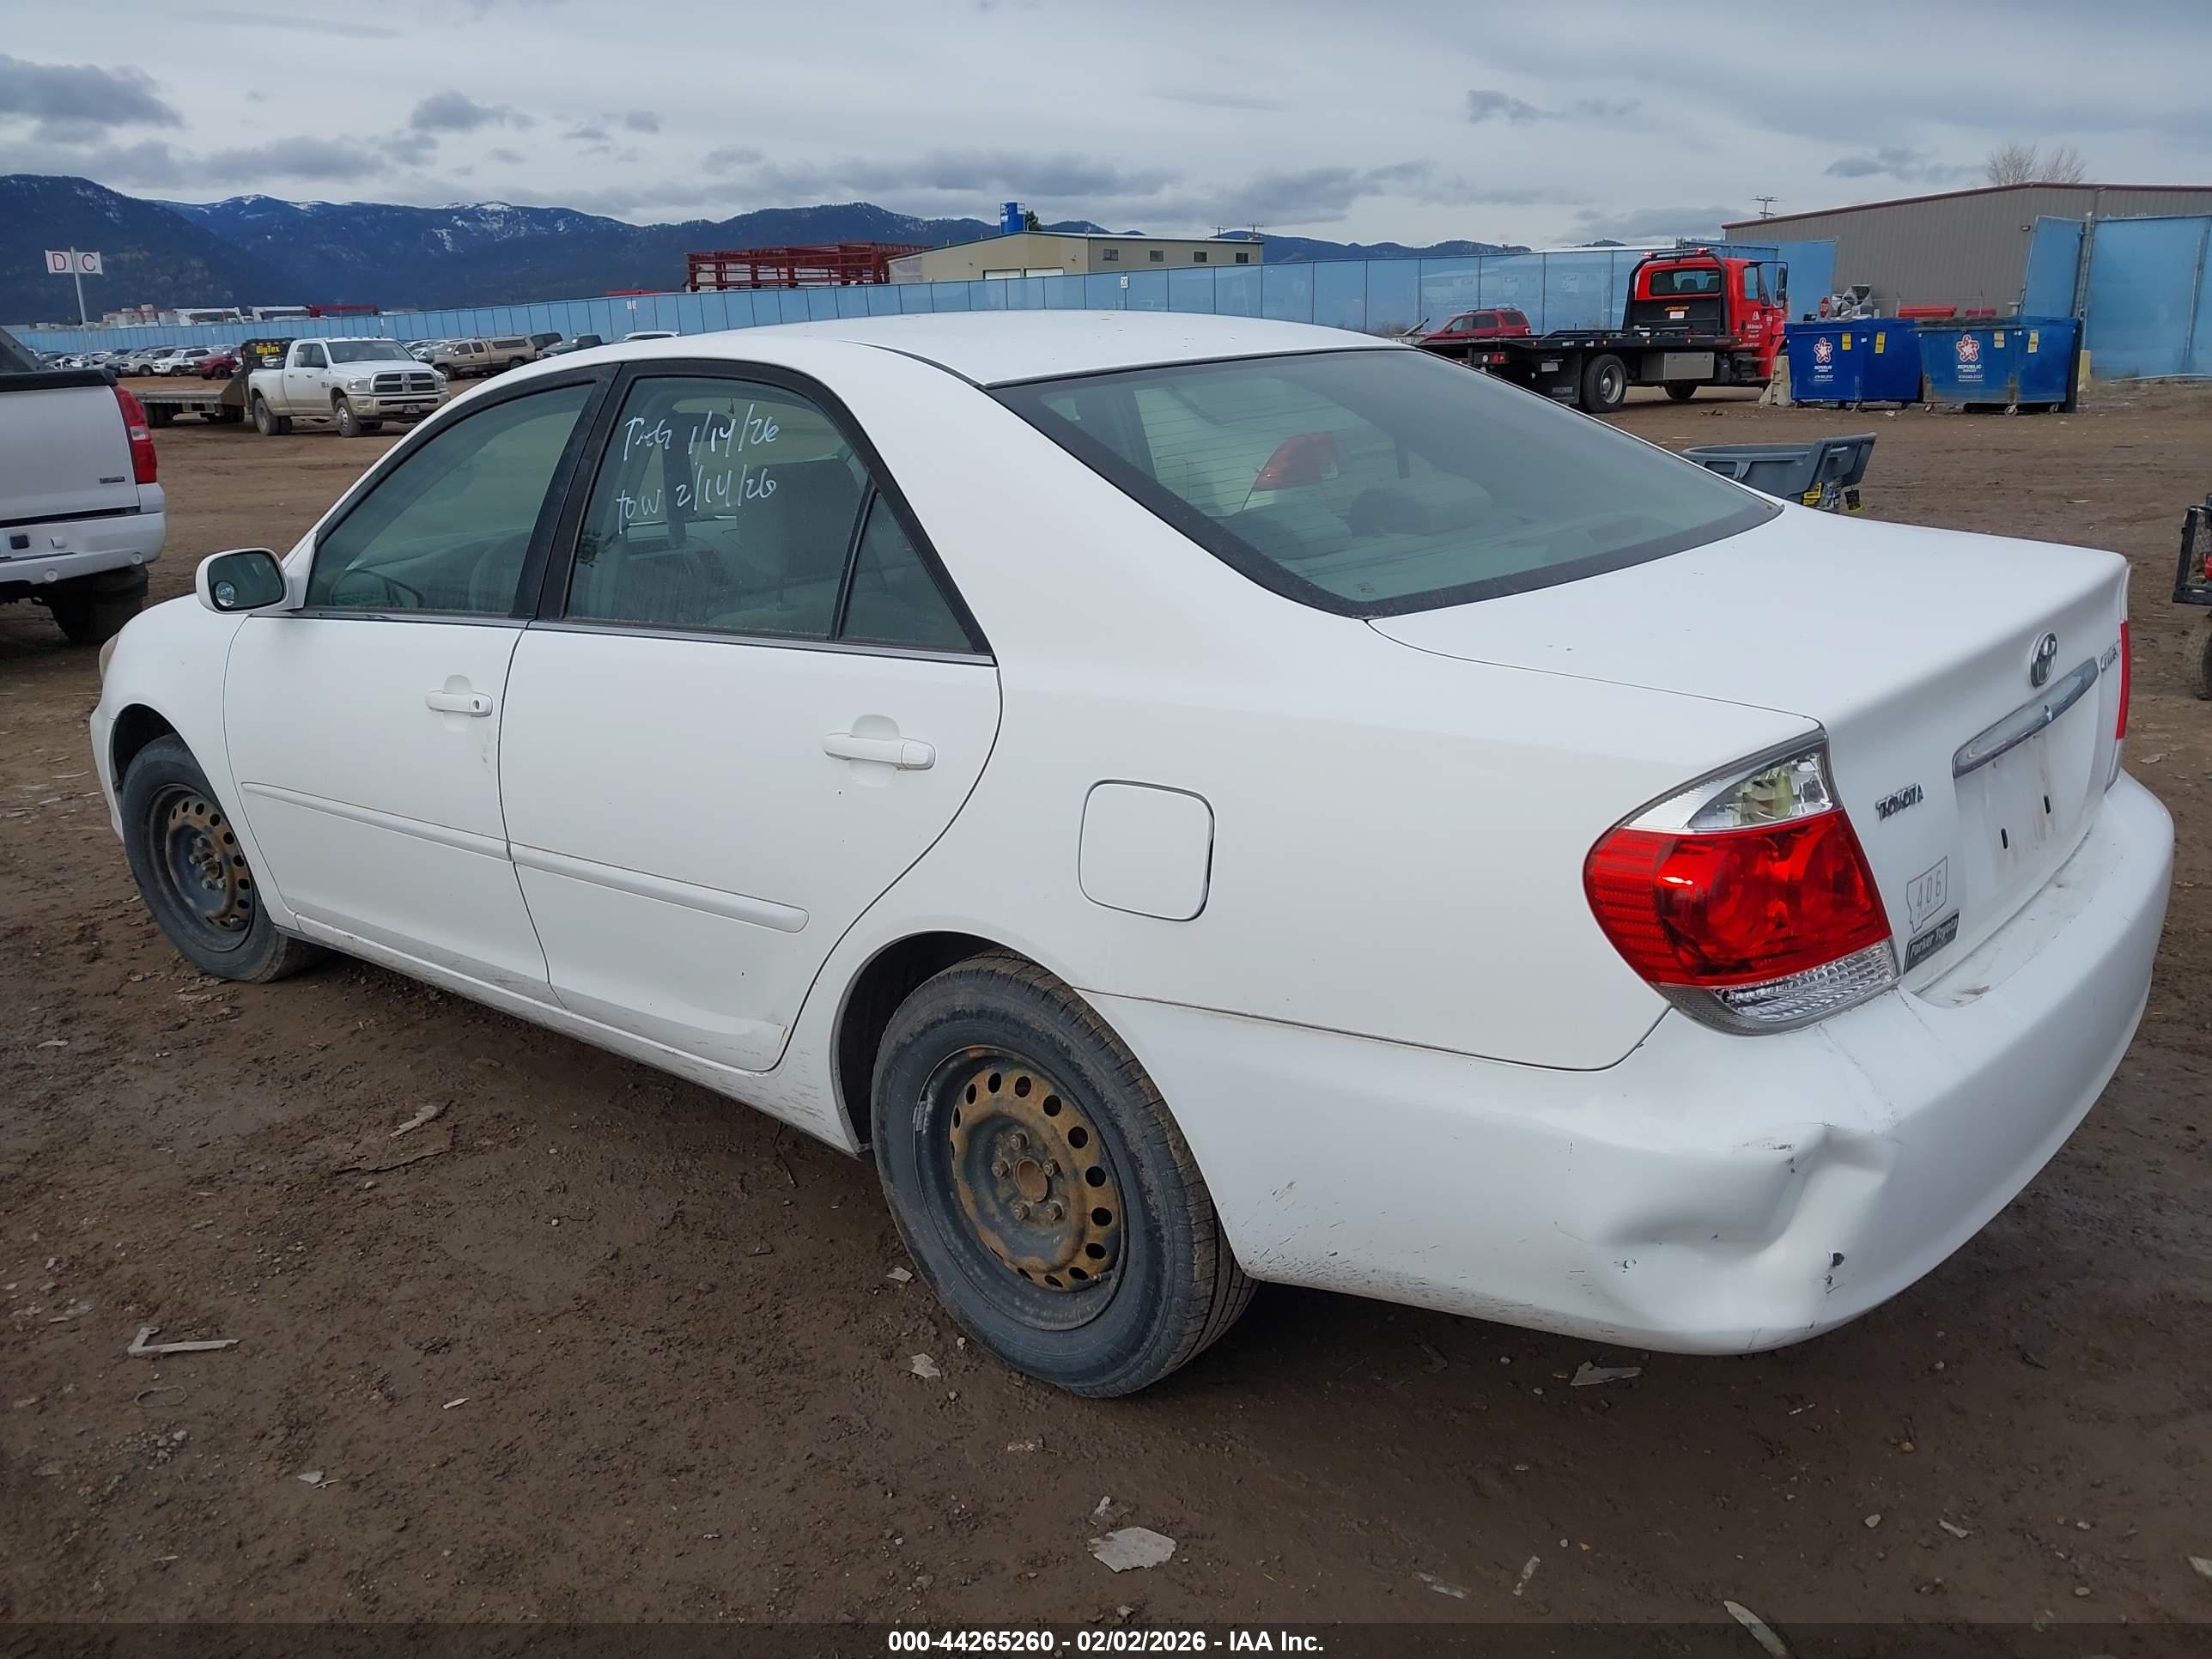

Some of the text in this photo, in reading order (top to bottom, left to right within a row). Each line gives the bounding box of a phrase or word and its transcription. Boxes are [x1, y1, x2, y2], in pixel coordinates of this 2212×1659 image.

[52, 253, 66, 270] D
[82, 254, 95, 271] C
[688, 404, 780, 465] 1/14/26
[676, 464, 777, 511] 2/14/26
[1875, 783, 1924, 822] TOYOTA
[1917, 870, 1942, 908] 406
